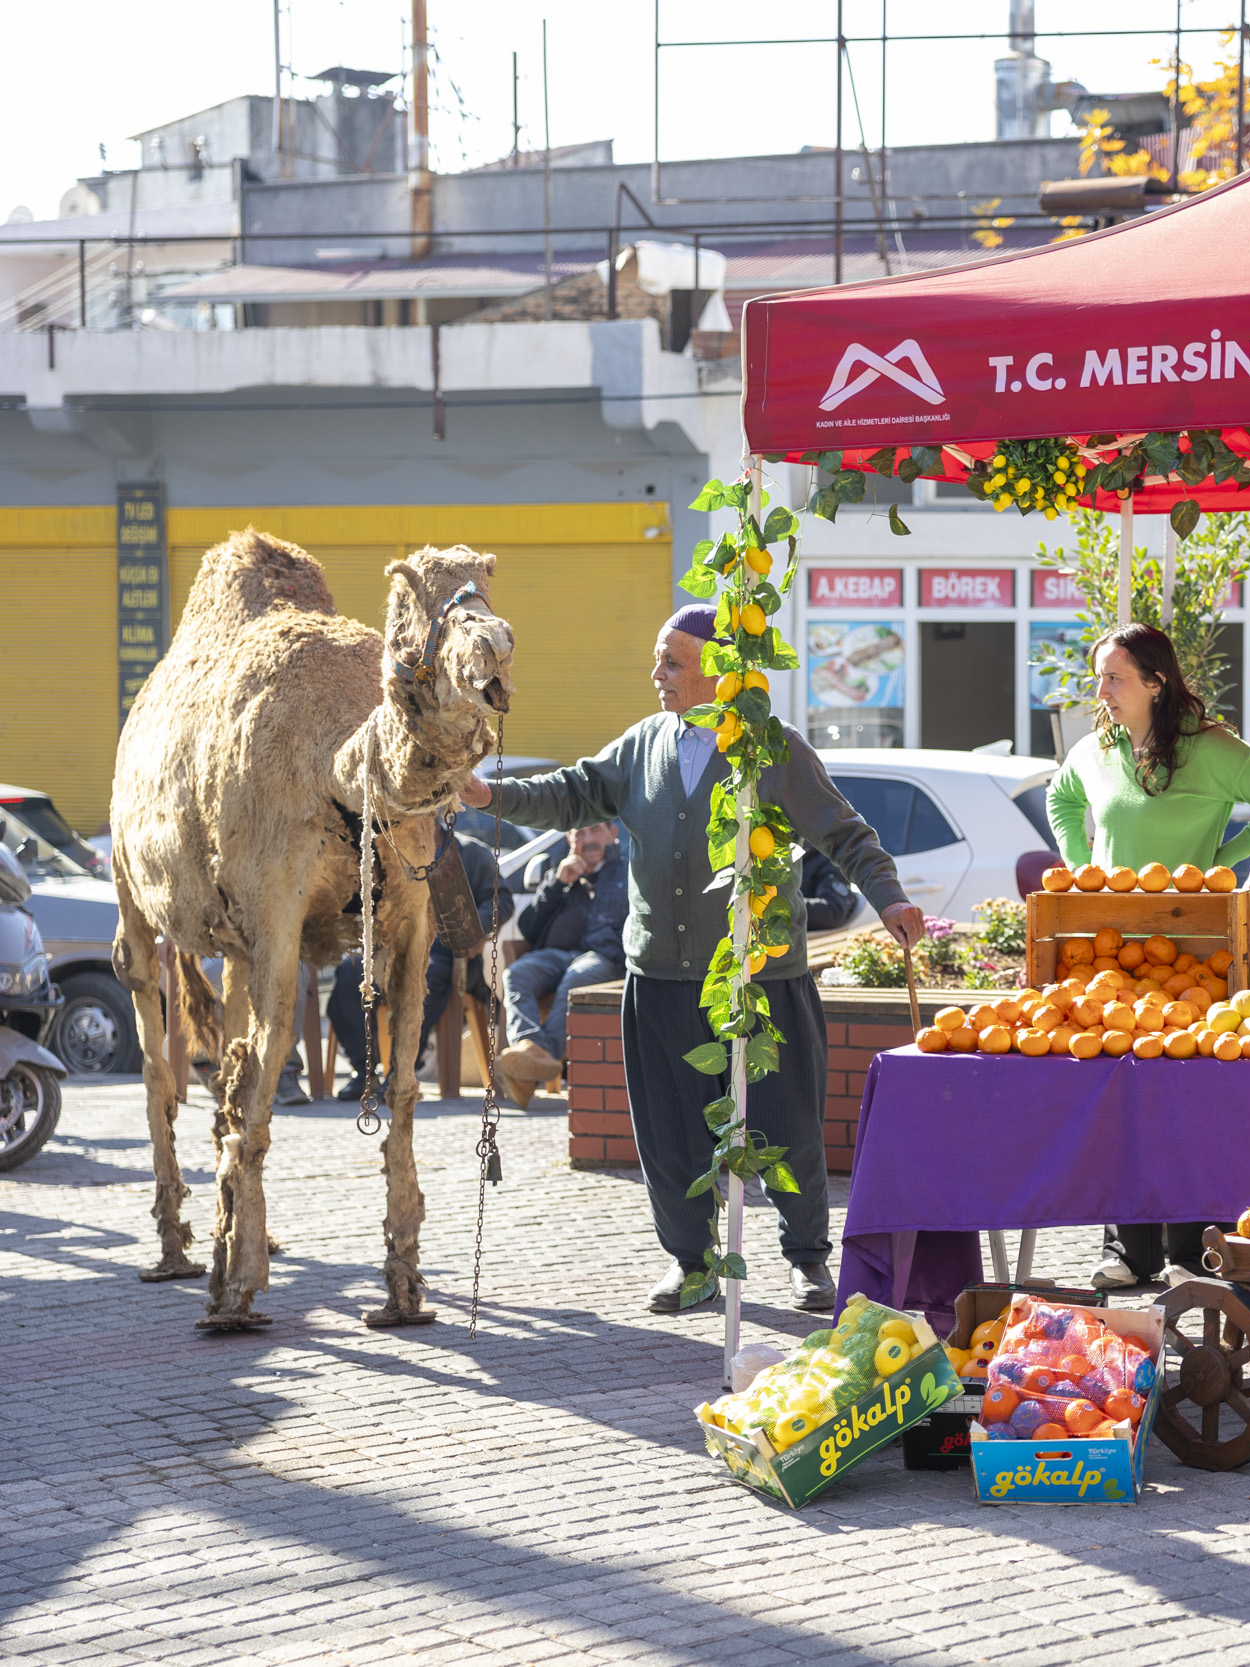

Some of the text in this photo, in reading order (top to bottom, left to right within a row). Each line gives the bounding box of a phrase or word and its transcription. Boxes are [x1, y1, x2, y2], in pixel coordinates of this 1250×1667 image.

[989, 352, 1067, 393] T.C.
[843, 418, 857, 426] AİLE
[857, 416, 891, 426] HİZMETLERİ
[891, 414, 915, 424] DAİRESİ
[816, 576, 897, 600] A.KEBAP
[931, 571, 1001, 599] BÖREK
[820, 1382, 911, 1476] gökalp
[989, 1460, 1102, 1497] gökalp
